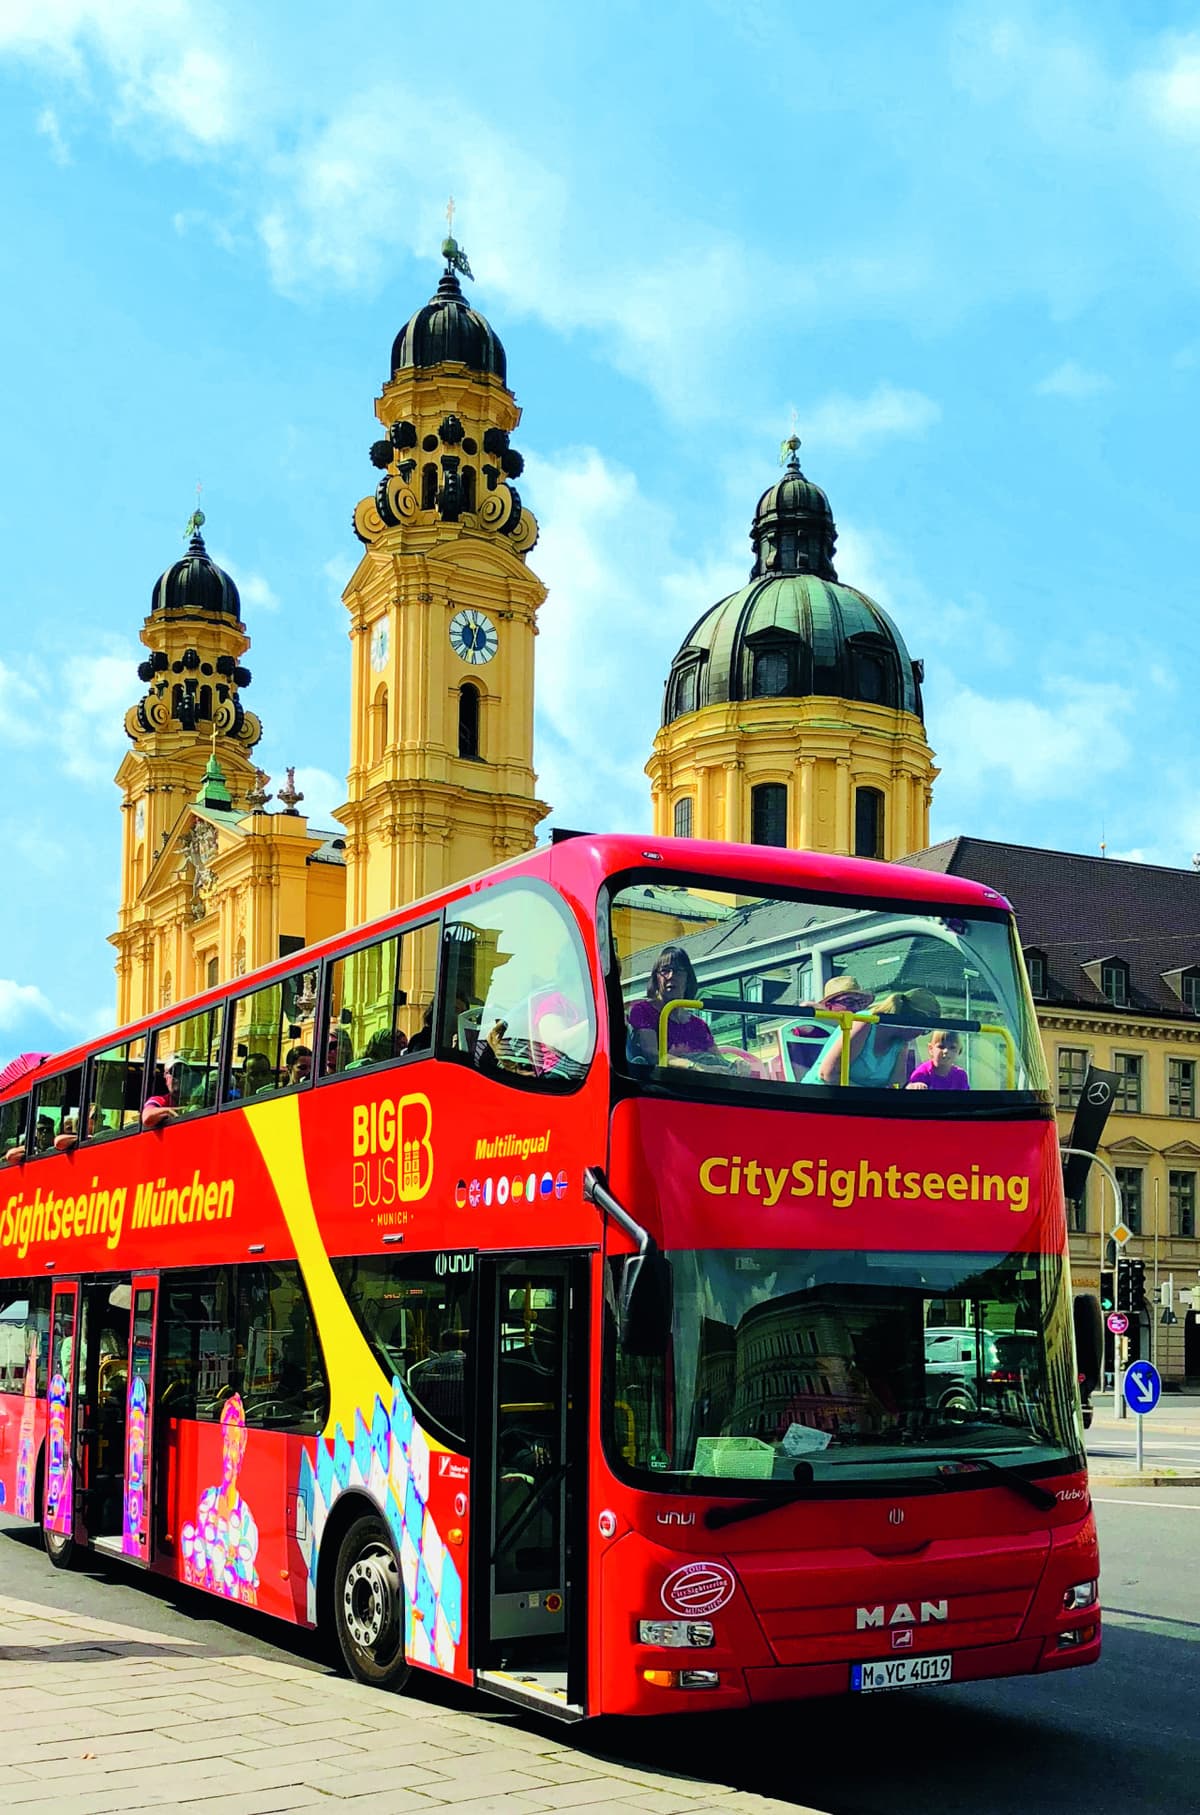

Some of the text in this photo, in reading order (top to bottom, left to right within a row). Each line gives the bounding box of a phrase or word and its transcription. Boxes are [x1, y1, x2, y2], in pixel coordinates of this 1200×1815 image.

[353, 1098, 396, 1157] BIG
[475, 1129, 551, 1161] Multilingual
[353, 1156, 396, 1208] BUS
[699, 1156, 1030, 1212] CitySightseeing
[131, 1169, 235, 1229] München
[377, 1211, 408, 1226] MUNICH
[670, 1579, 729, 1599] CitySightseeing
[856, 1599, 948, 1630] MAN
[863, 1658, 950, 1687] M YC 4019
